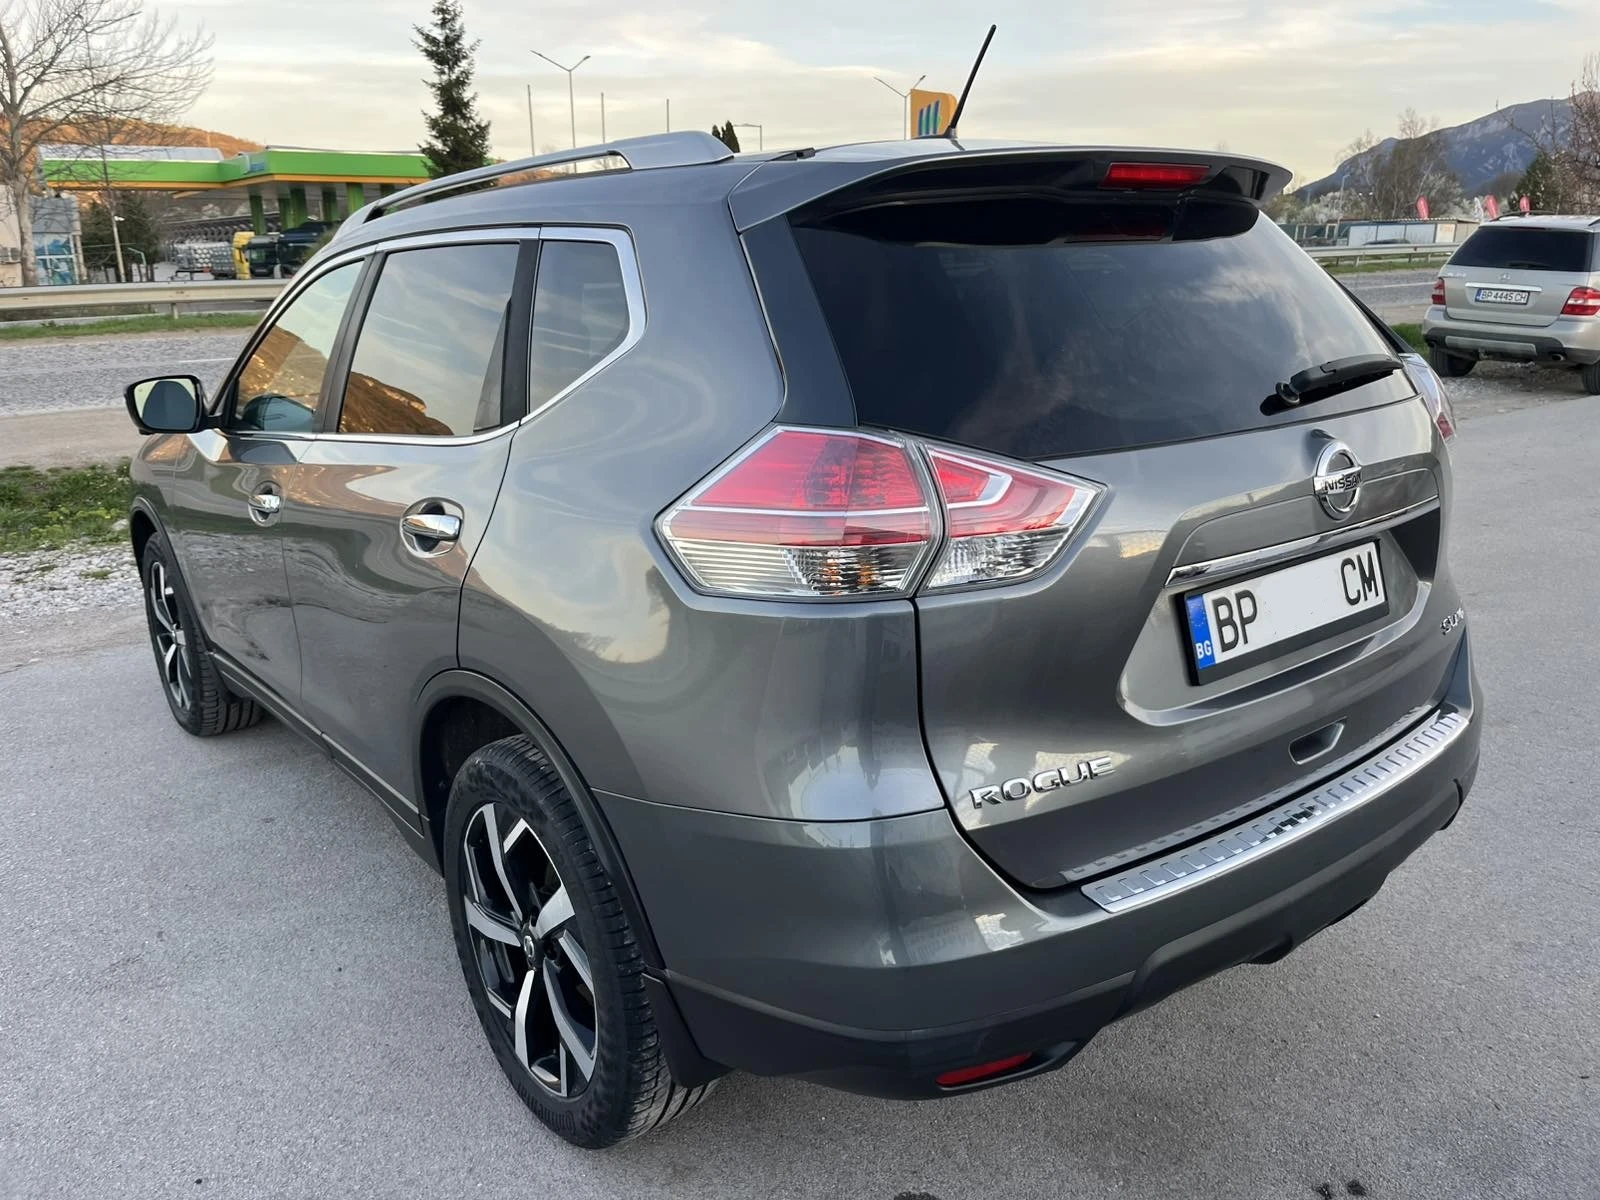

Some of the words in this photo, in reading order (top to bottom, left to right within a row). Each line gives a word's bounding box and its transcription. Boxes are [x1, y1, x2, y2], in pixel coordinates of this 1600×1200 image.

[1324, 471, 1362, 491] NISSAN
[1212, 589, 1257, 652] BP
[1339, 550, 1380, 606] CM
[1196, 642, 1213, 659] BG
[968, 755, 1116, 810] ROGUE
